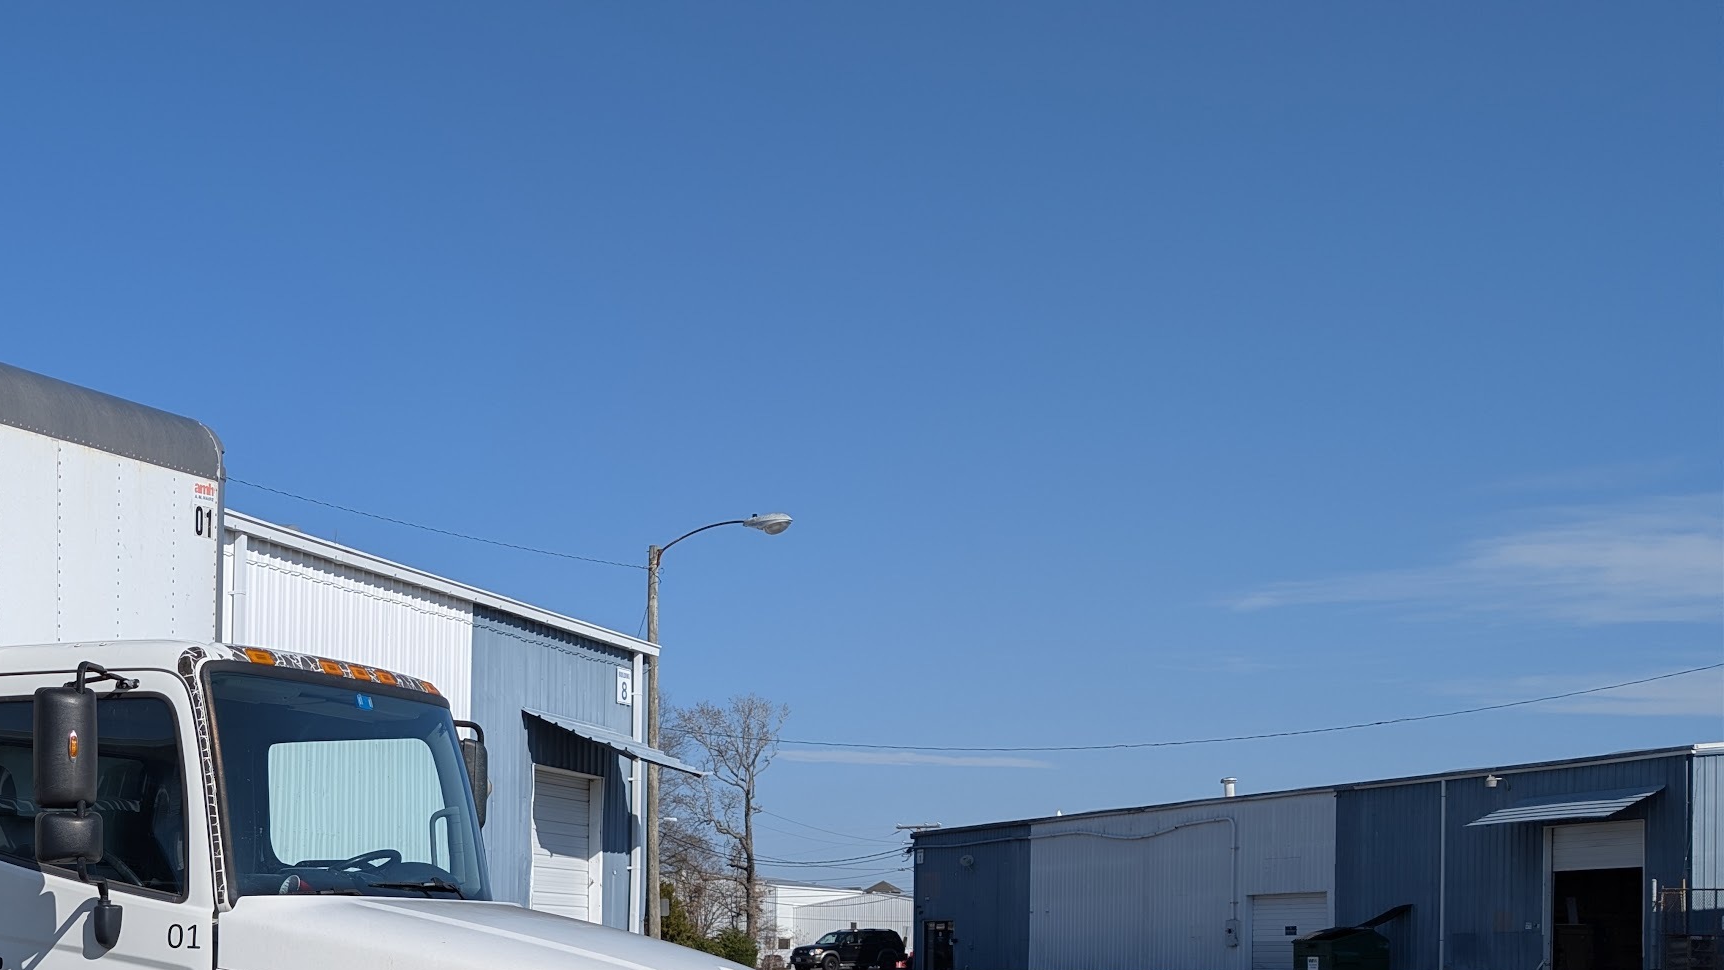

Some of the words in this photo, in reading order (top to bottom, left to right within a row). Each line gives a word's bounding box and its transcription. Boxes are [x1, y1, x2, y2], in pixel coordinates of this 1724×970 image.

[195, 505, 212, 539] 01
[621, 681, 628, 701] 8
[167, 923, 201, 950] 01
